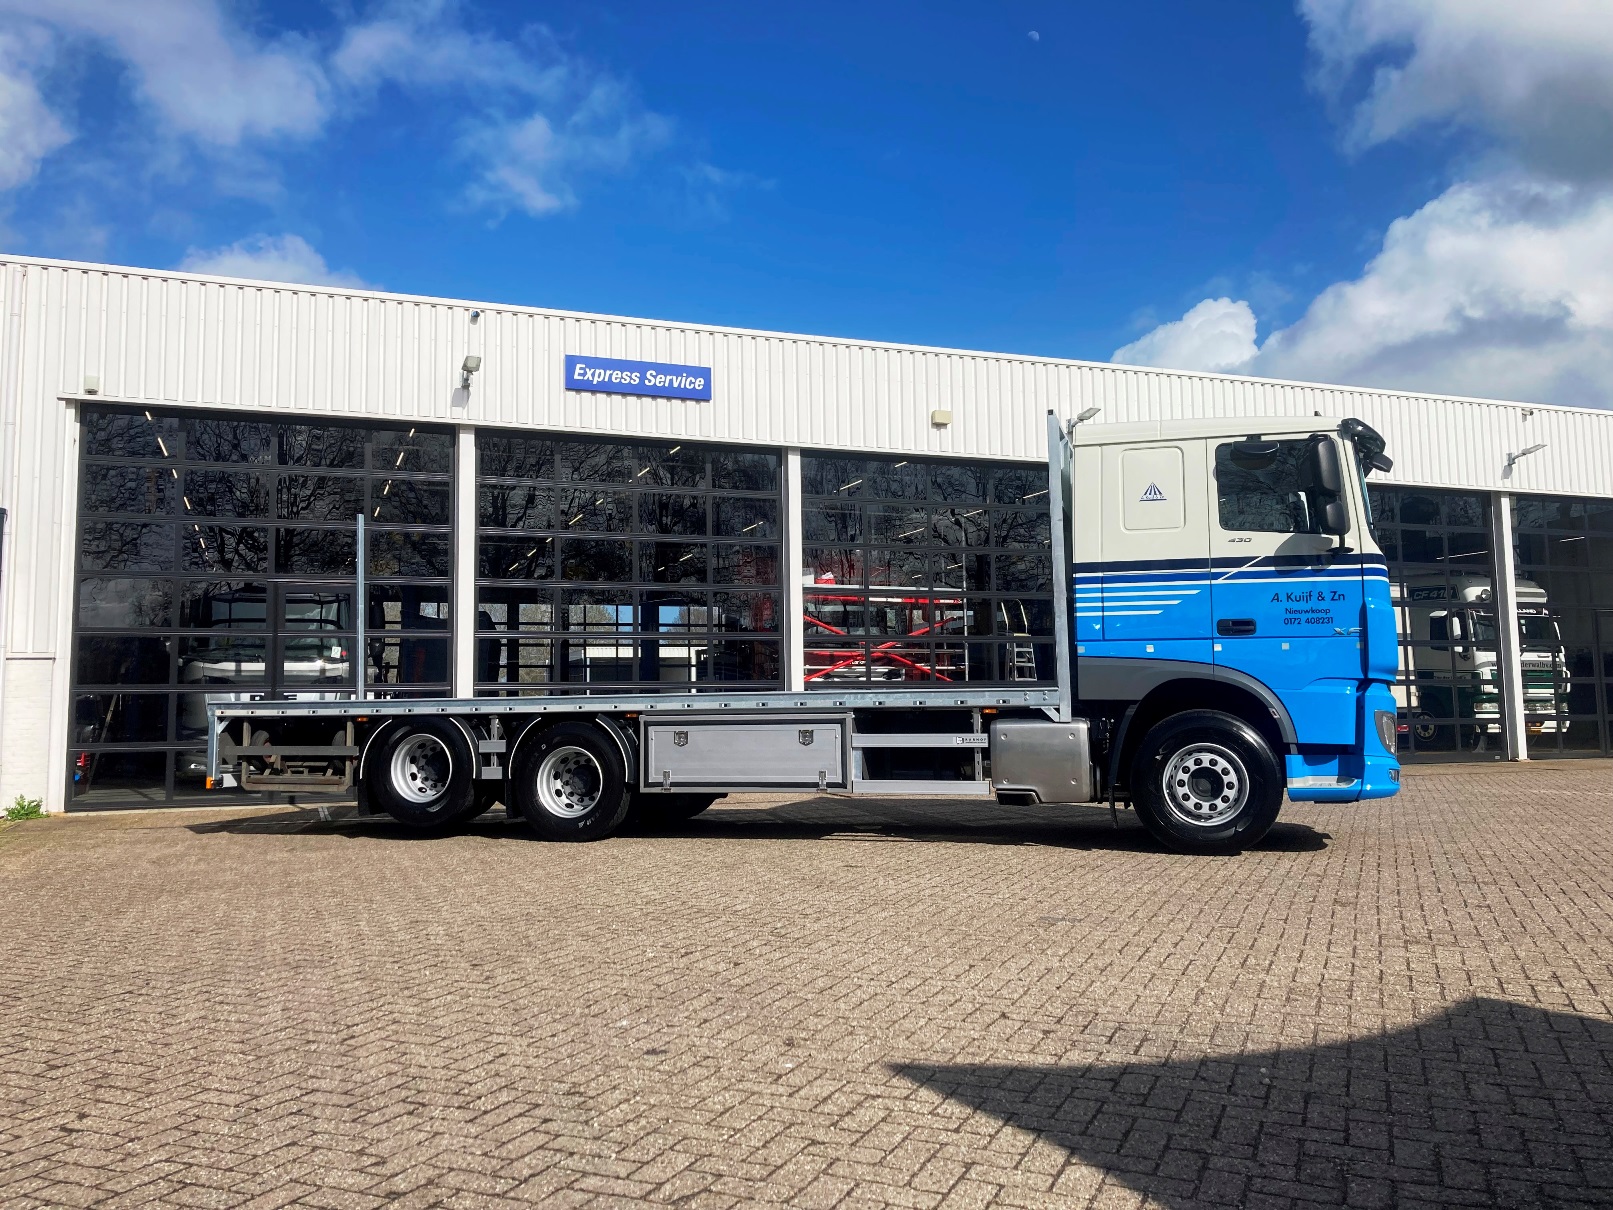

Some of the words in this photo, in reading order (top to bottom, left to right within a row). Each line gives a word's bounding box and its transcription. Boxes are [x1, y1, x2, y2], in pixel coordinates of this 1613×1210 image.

[573, 363, 641, 385] Express
[644, 369, 705, 390] Service
[1270, 592, 1283, 603] A.
[1286, 590, 1313, 604] Kuijf
[1317, 590, 1326, 602] &
[1330, 590, 1346, 602] Zn
[1285, 606, 1331, 616] Nieuwkoop
[1283, 617, 1302, 626] 0172
[1304, 616, 1334, 625] 408231
